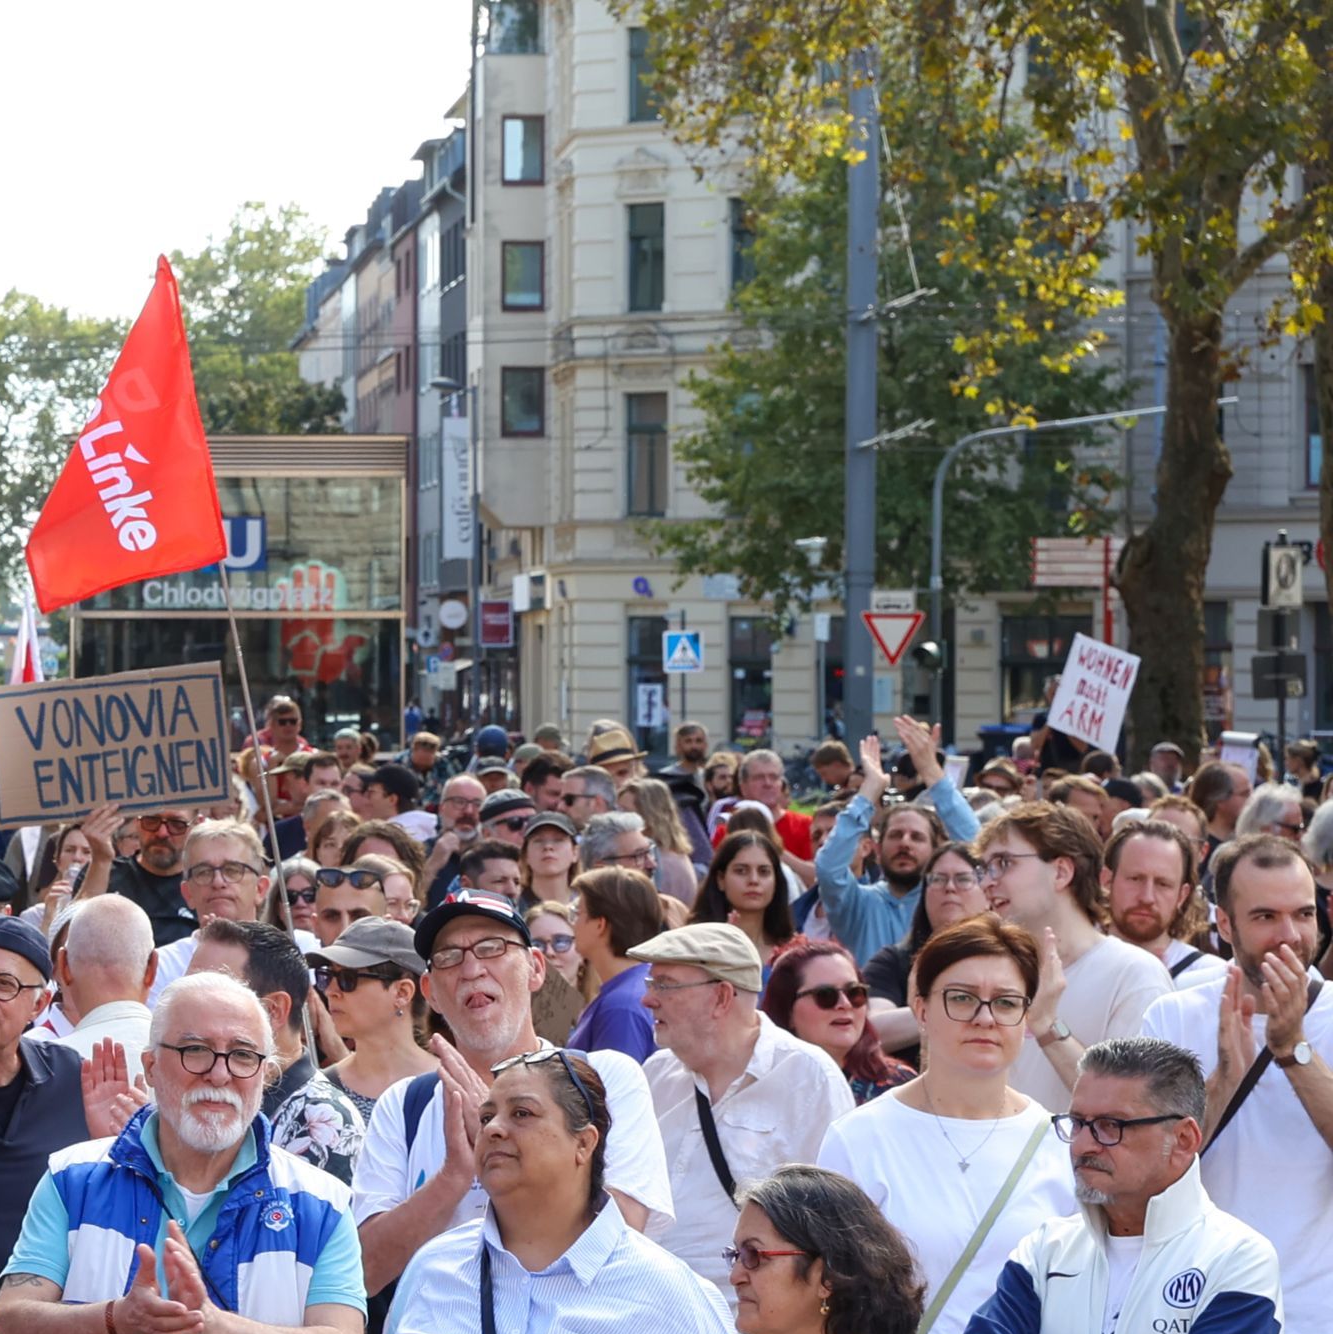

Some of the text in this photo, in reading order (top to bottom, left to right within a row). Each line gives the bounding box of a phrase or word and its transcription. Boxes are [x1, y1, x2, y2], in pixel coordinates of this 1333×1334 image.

[78, 420, 157, 551] Linke
[222, 519, 262, 568] U
[142, 580, 332, 611] Chlodwigplatz
[1077, 644, 1135, 691] WOHNEN
[15, 685, 199, 751] VONOVIA
[1058, 700, 1104, 743] ARM
[33, 737, 220, 809] ENTEIGNEN
[1152, 1319, 1190, 1334] QAT
